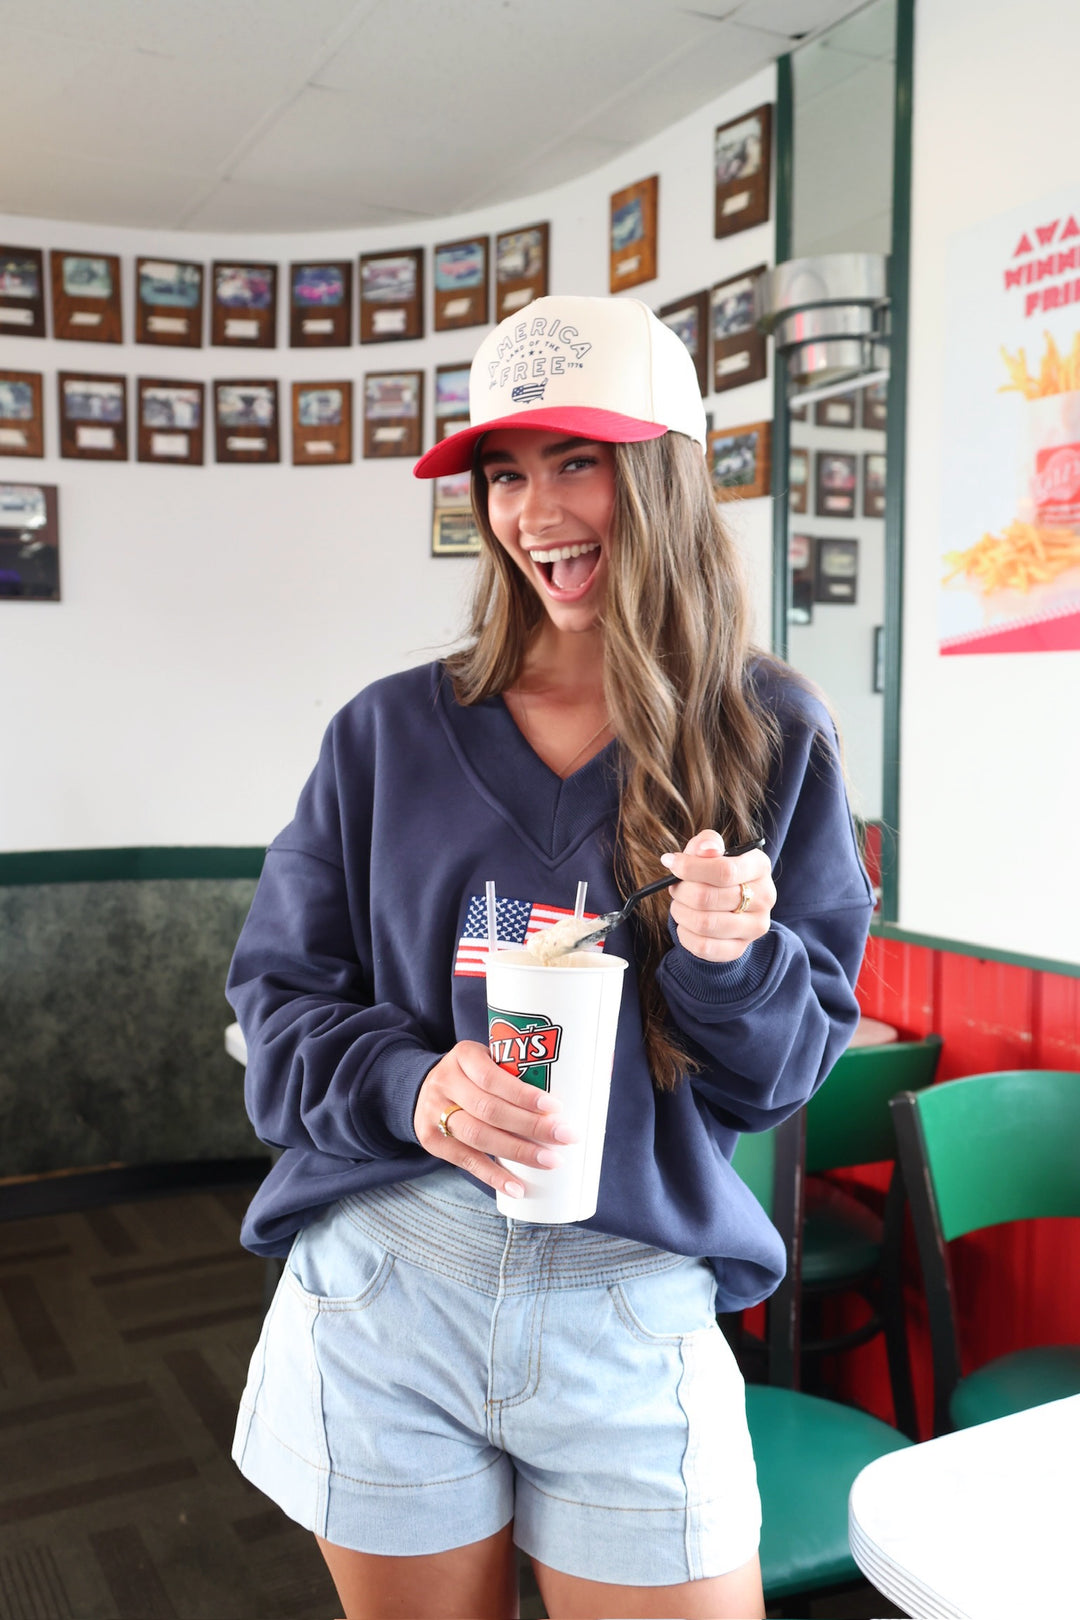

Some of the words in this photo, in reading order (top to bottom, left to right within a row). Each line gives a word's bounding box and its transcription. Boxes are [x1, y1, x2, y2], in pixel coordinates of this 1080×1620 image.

[1003, 246, 1080, 291] WINN
[488, 318, 592, 379] AMERICA
[545, 341, 560, 352] THE
[500, 357, 565, 388] FREE
